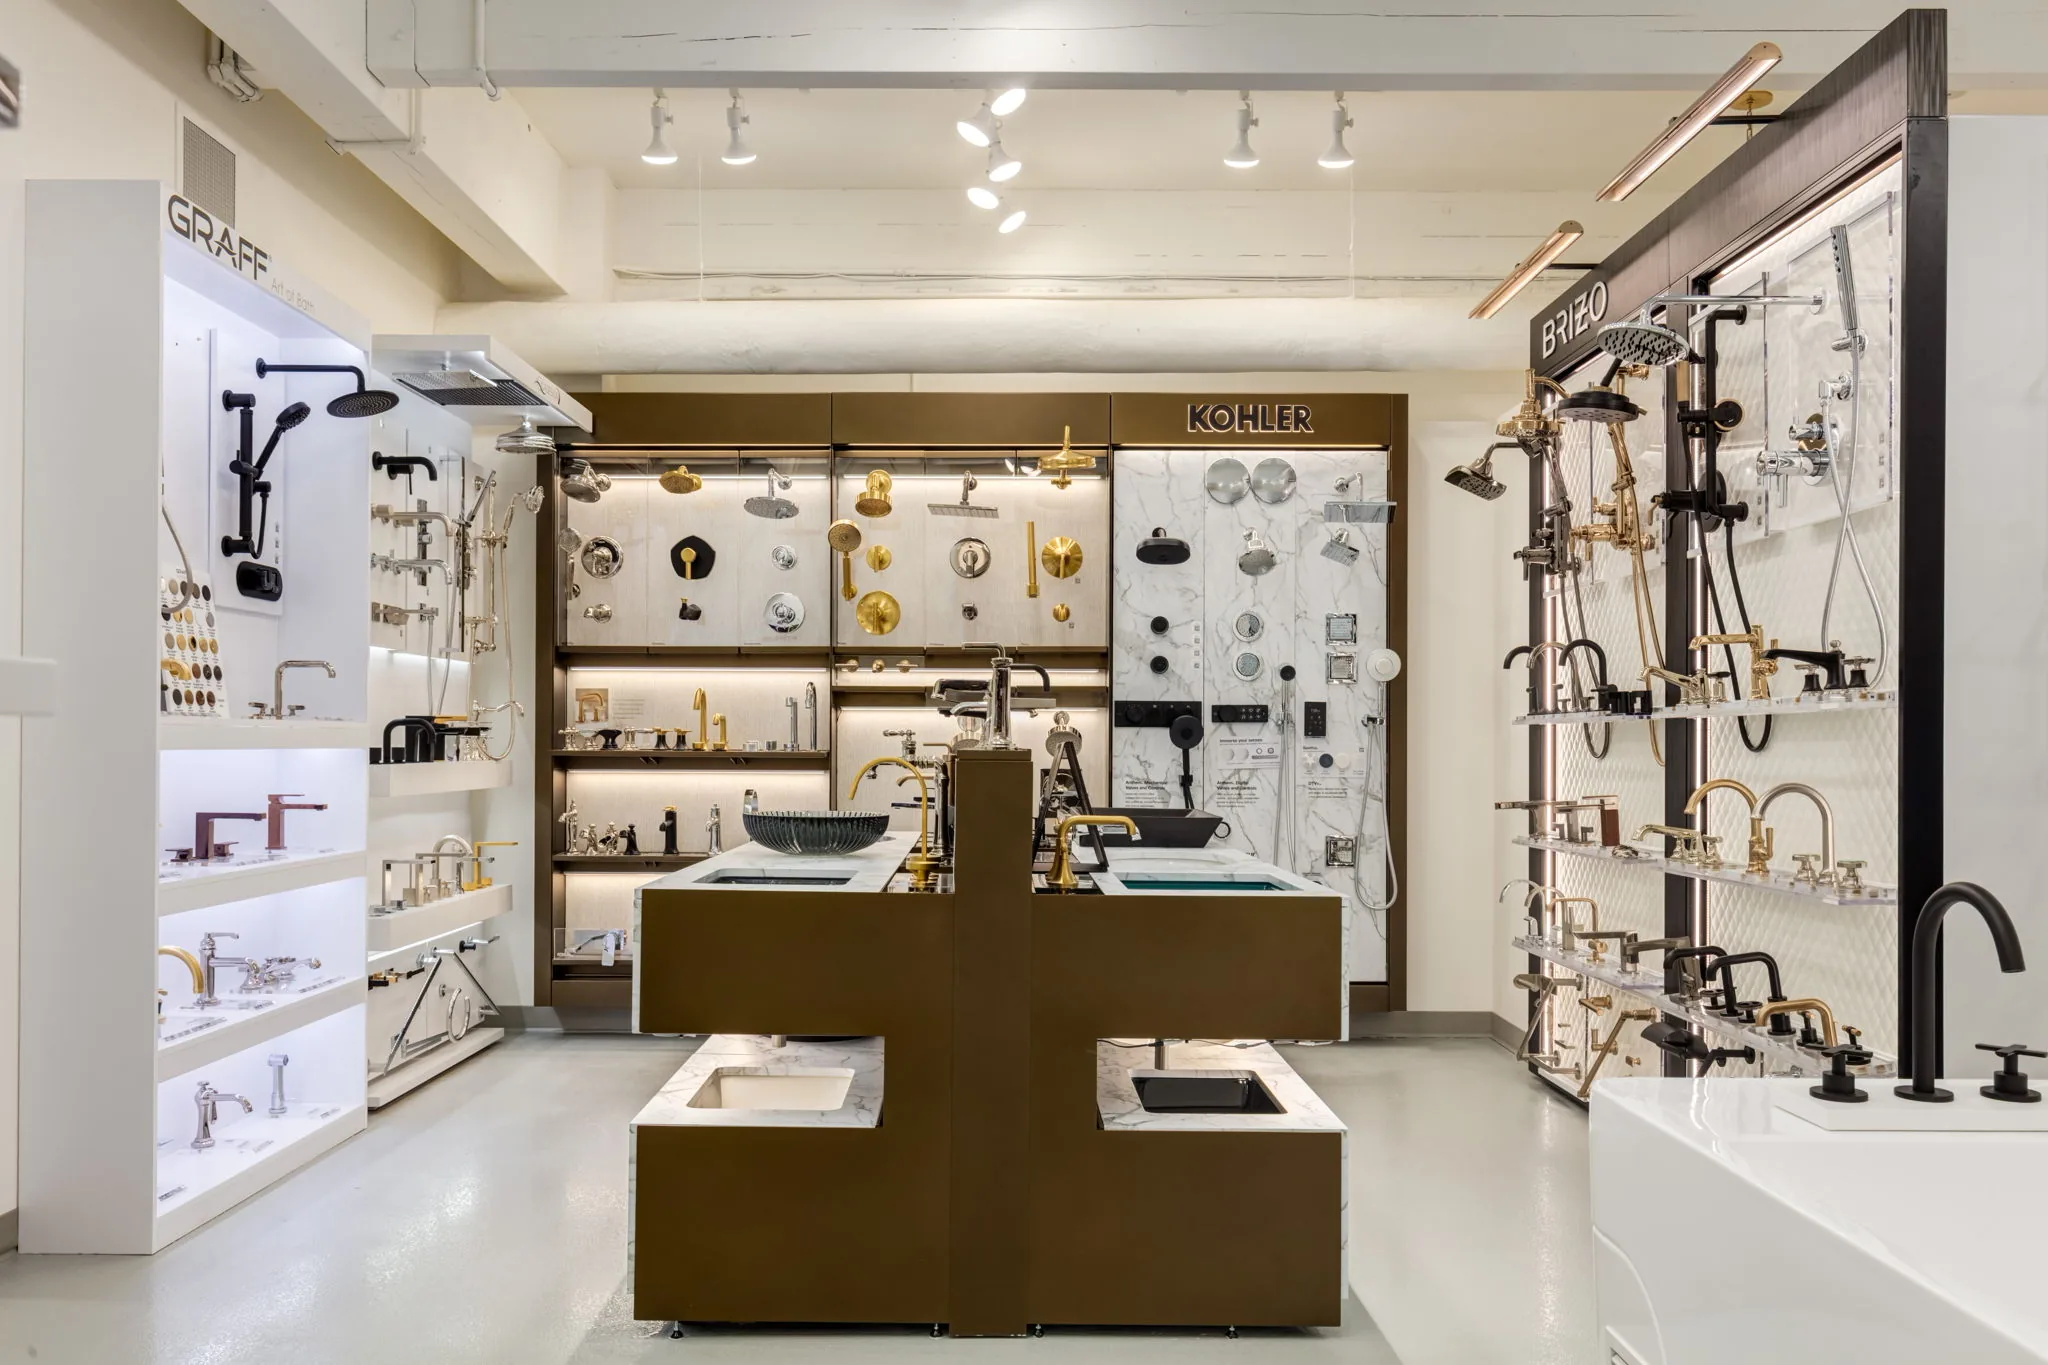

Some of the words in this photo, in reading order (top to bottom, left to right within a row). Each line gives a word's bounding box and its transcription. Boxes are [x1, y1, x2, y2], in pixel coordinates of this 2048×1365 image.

[168, 194, 268, 280] GRAFF
[271, 277, 284, 296] Art
[1542, 281, 1607, 360] BRIZO
[1187, 404, 1314, 433] KOHLER
